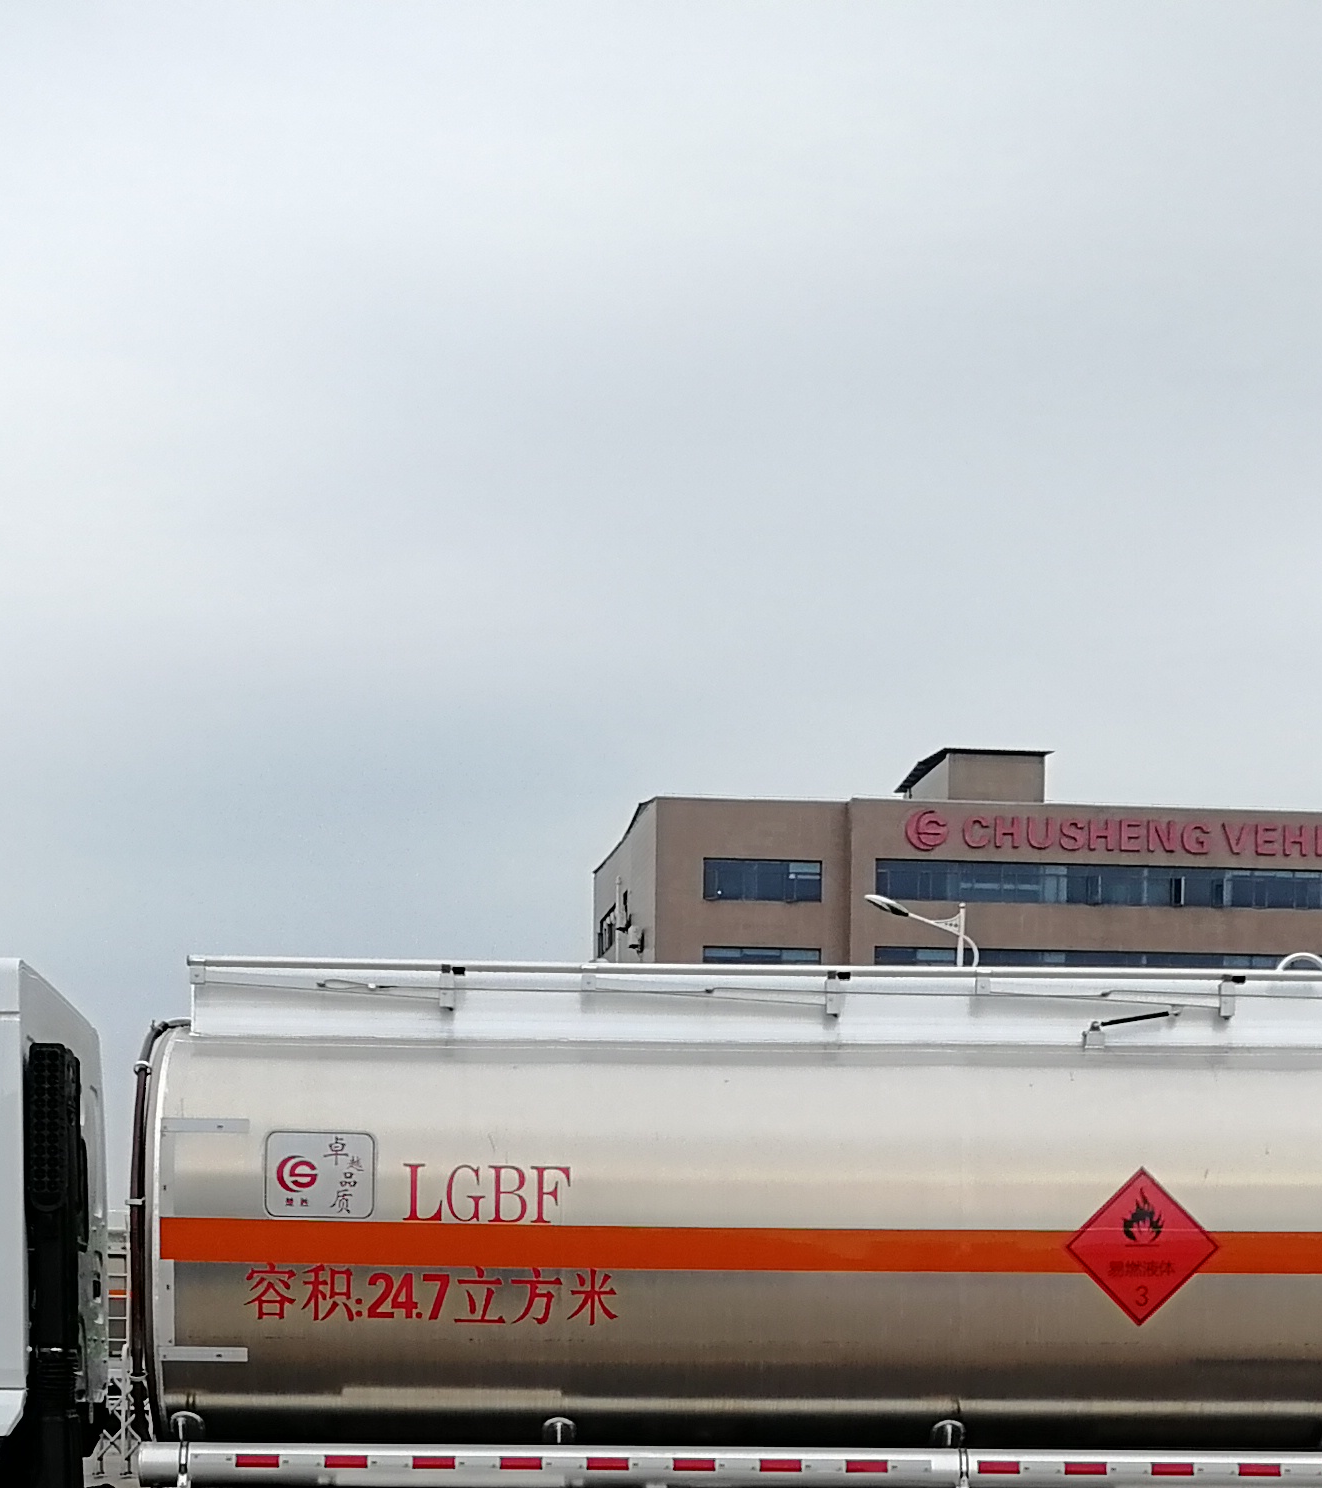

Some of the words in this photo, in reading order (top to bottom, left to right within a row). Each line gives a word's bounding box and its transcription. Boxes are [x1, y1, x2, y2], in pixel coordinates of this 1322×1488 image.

[962, 815, 1213, 855] CHUSHENG
[402, 1163, 571, 1224] LGBF
[1135, 1285, 1149, 1307] 3
